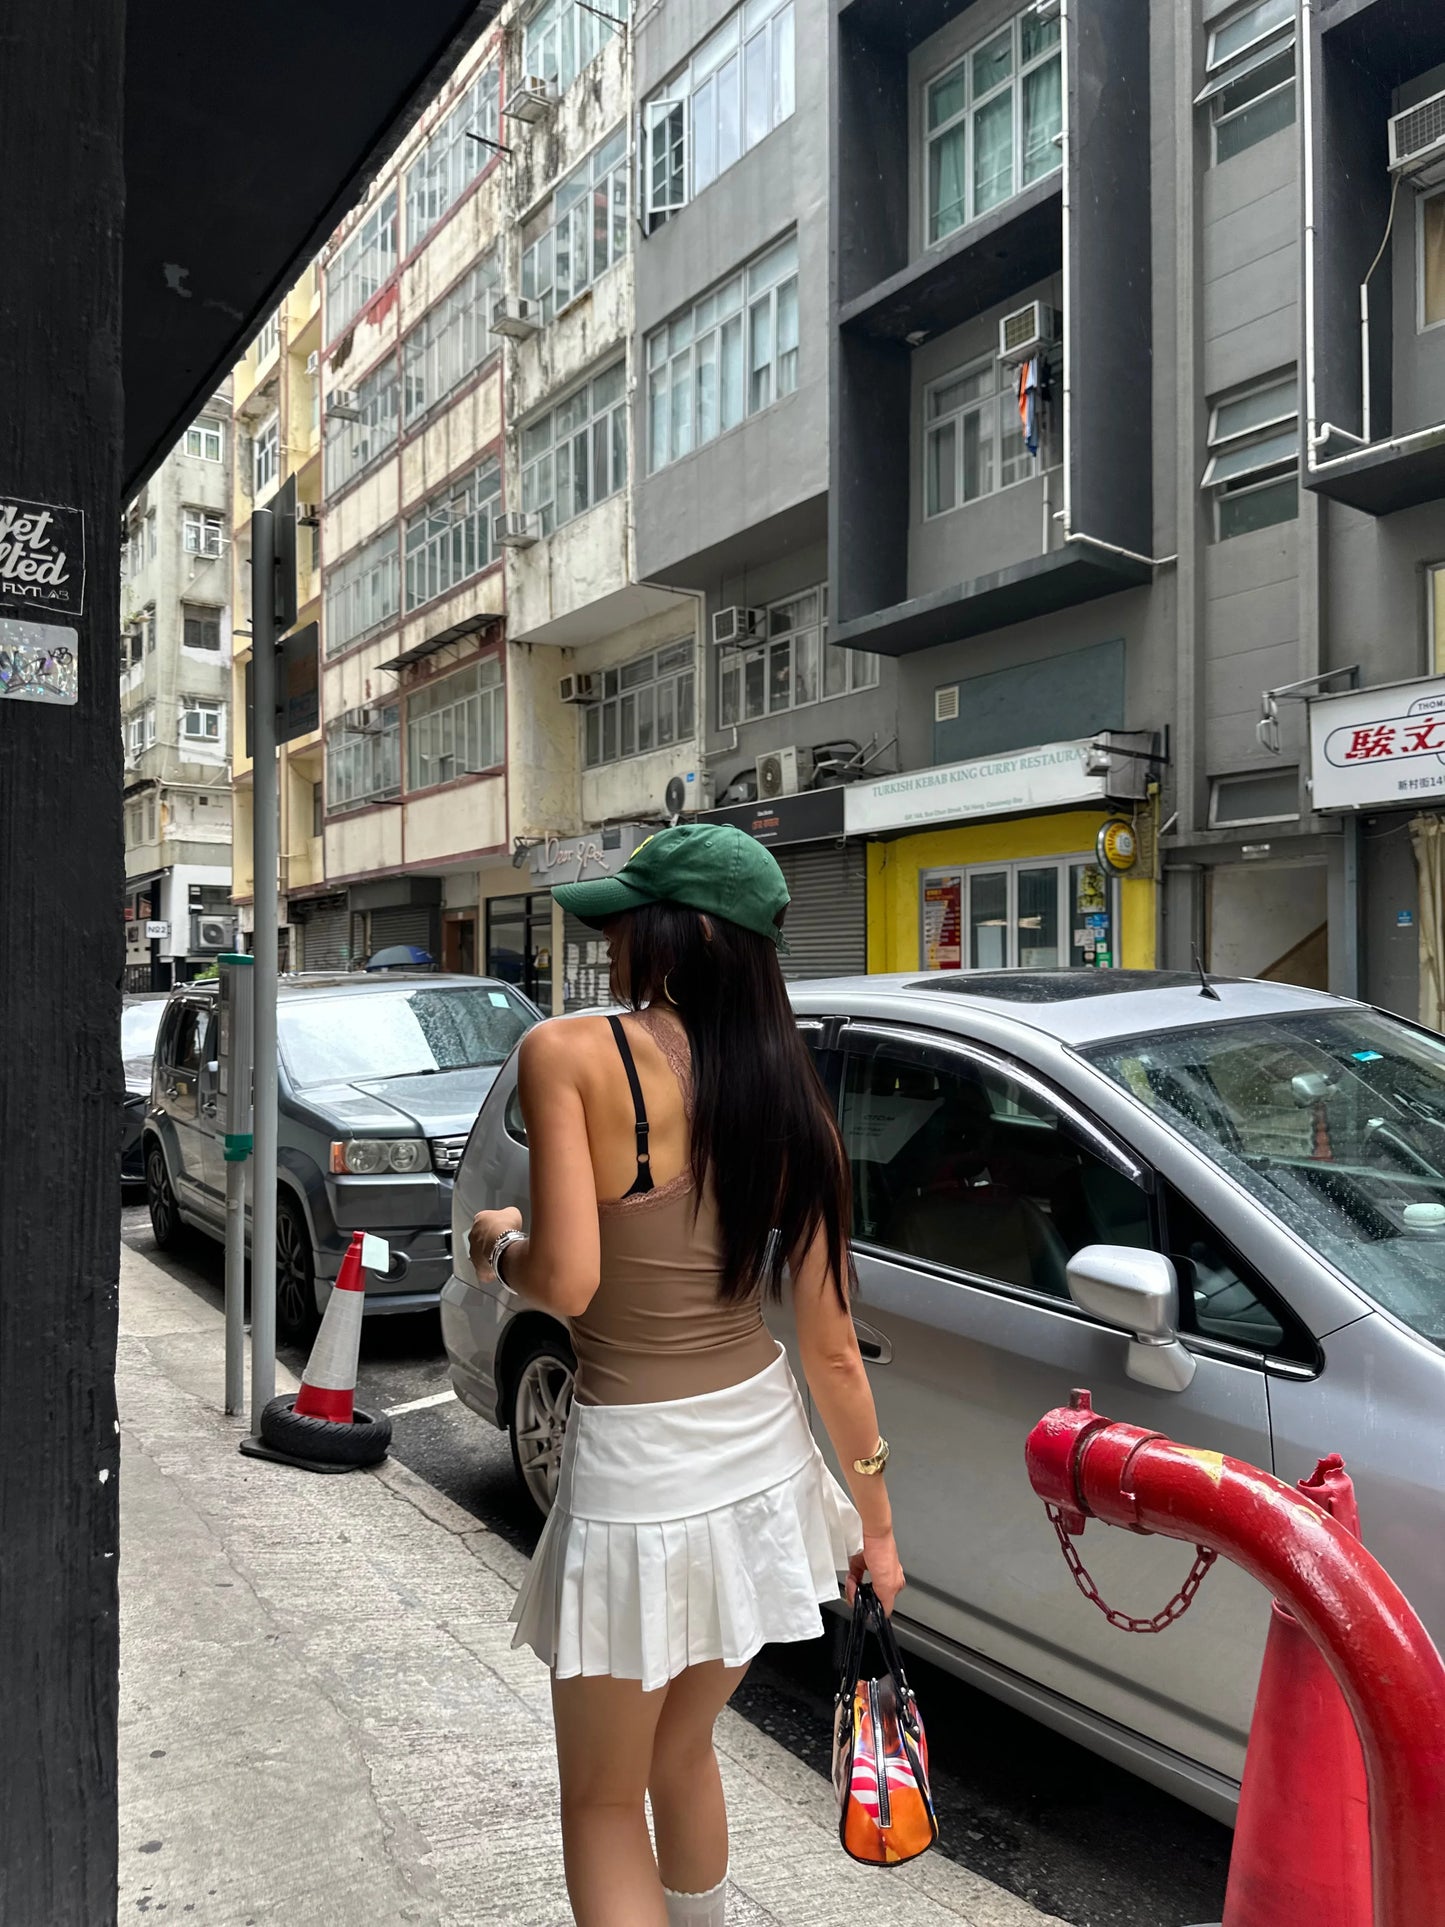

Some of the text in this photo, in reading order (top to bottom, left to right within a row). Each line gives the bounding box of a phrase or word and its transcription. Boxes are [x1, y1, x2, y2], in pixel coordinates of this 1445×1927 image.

[1417, 700, 1445, 711] THOM
[1345, 716, 1445, 759] 駿文
[872, 779, 914, 797] TURKISH
[915, 773, 948, 790] KEBAB
[948, 768, 978, 783] KING
[979, 760, 1019, 777] CURRY
[1398, 775, 1445, 790] 新村街14
